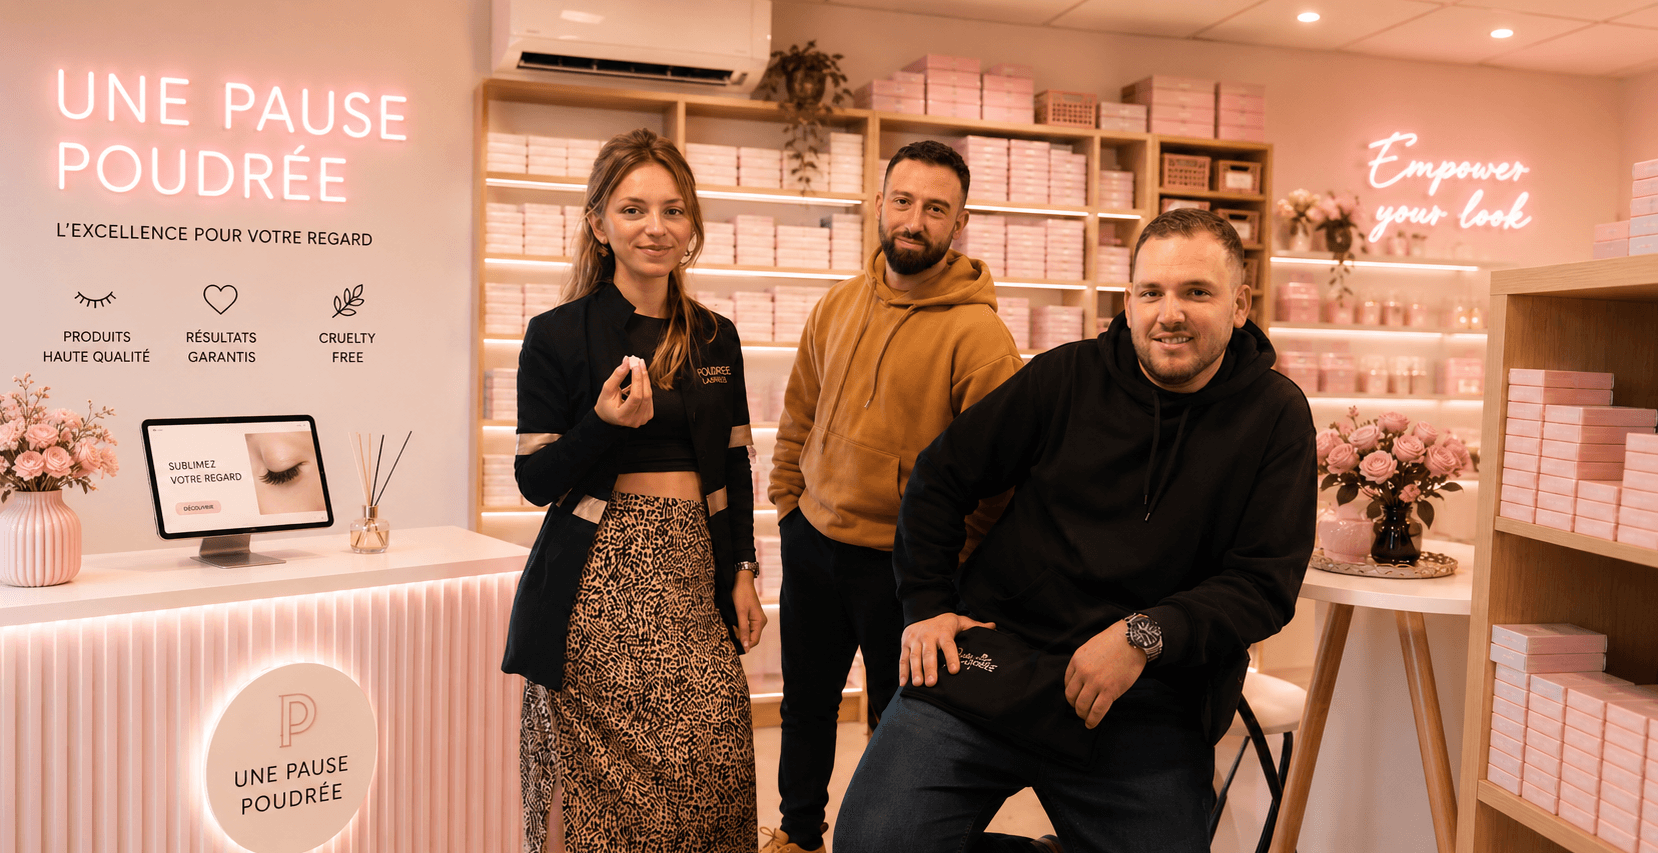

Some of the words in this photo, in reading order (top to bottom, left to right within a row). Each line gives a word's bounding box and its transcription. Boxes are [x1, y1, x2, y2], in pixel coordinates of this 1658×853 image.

[57, 68, 190, 127] UNE
[224, 82, 408, 142] PAUSE
[57, 141, 348, 203] POUDRÉE
[1368, 131, 1530, 197] Empower
[1368, 204, 1448, 243] your
[1459, 188, 1533, 230] look
[194, 227, 242, 243] POUR
[247, 229, 302, 245] VOTRE
[307, 231, 373, 247] REGARD
[63, 330, 131, 343] PRODUITS
[186, 328, 257, 344] RÉSULTATS
[318, 332, 376, 344] CRUELTY
[43, 350, 89, 363] HAUTE
[92, 348, 150, 364] QUALITÉ
[187, 351, 256, 363] GARANTIS
[332, 351, 364, 363] FREE
[168, 460, 216, 471] SUBLIMEZ
[170, 474, 202, 485] VOTRE
[204, 472, 242, 483] REGARD
[278, 692, 317, 749] P
[234, 765, 278, 788] UNE
[286, 755, 349, 780] PAUSE
[241, 781, 343, 815] POUDRÉE
